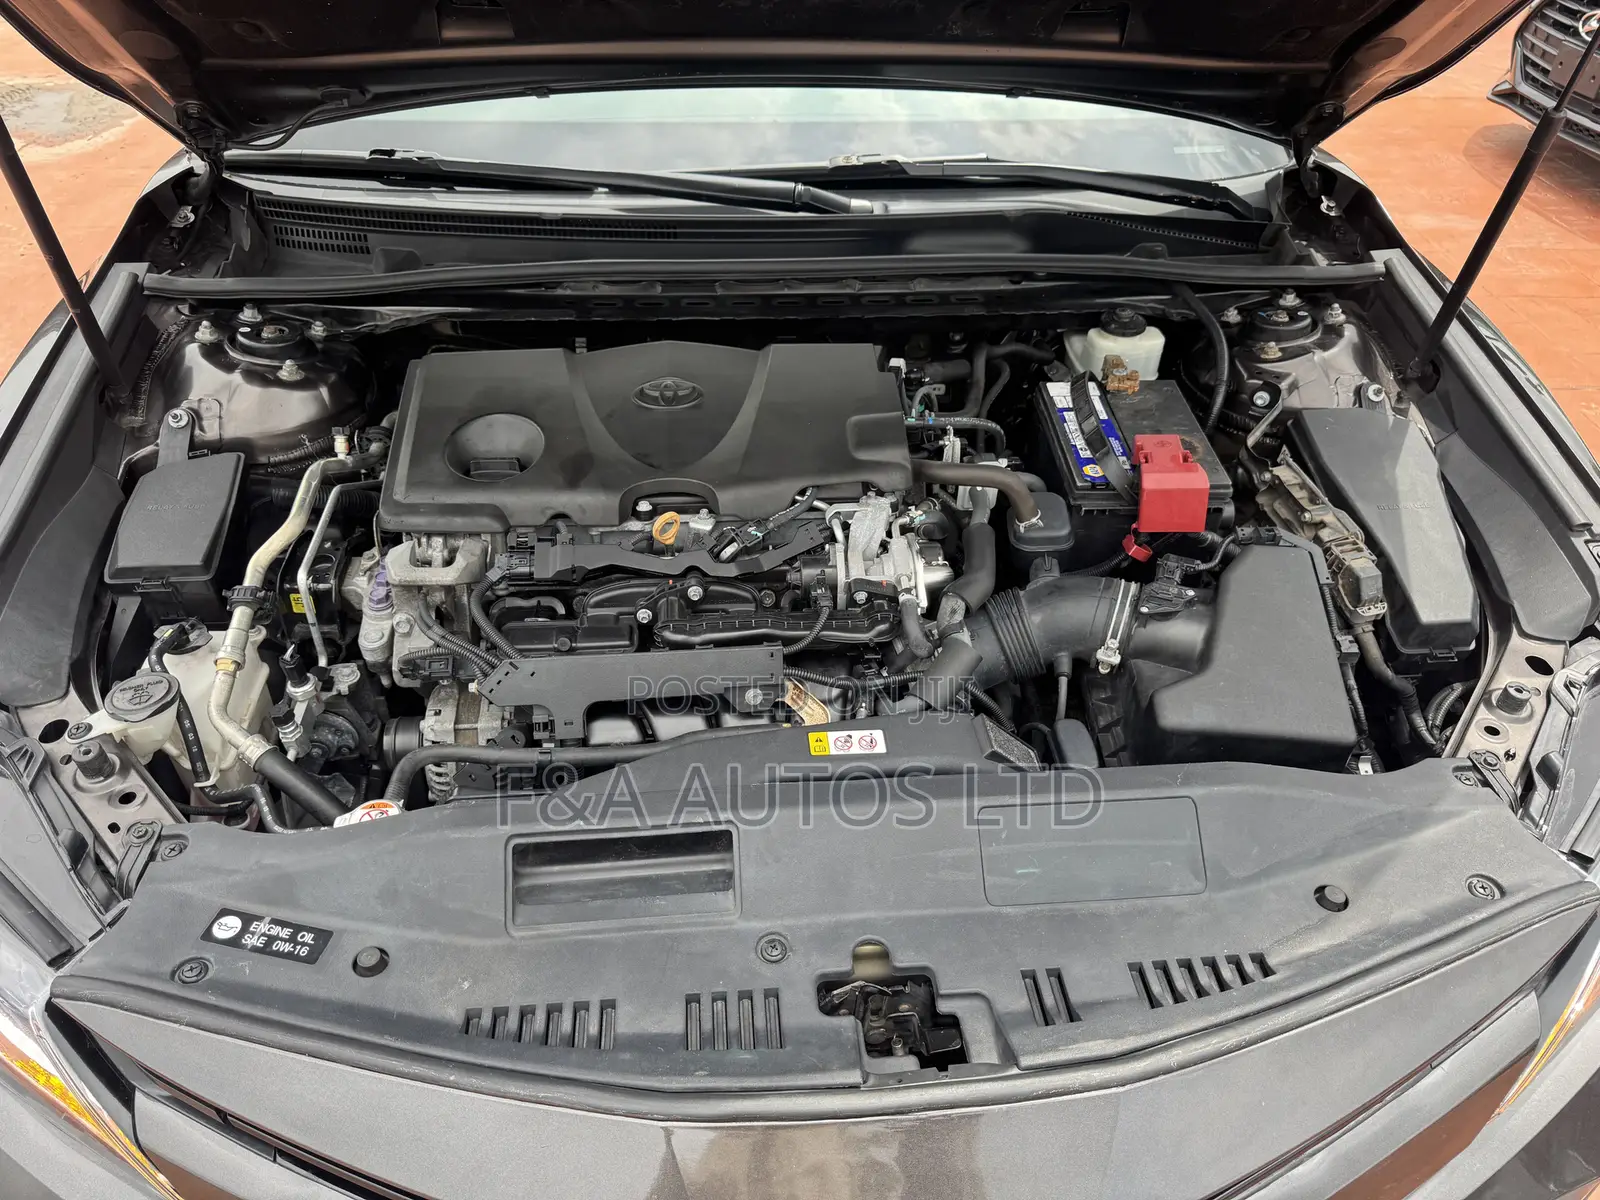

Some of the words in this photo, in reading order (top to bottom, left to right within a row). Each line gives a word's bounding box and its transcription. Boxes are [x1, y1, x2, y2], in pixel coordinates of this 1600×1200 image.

[249, 921, 294, 939] ENGINE
[297, 931, 316, 944] OIL
[241, 933, 268, 947] SAE
[272, 940, 310, 956] 0W-16
